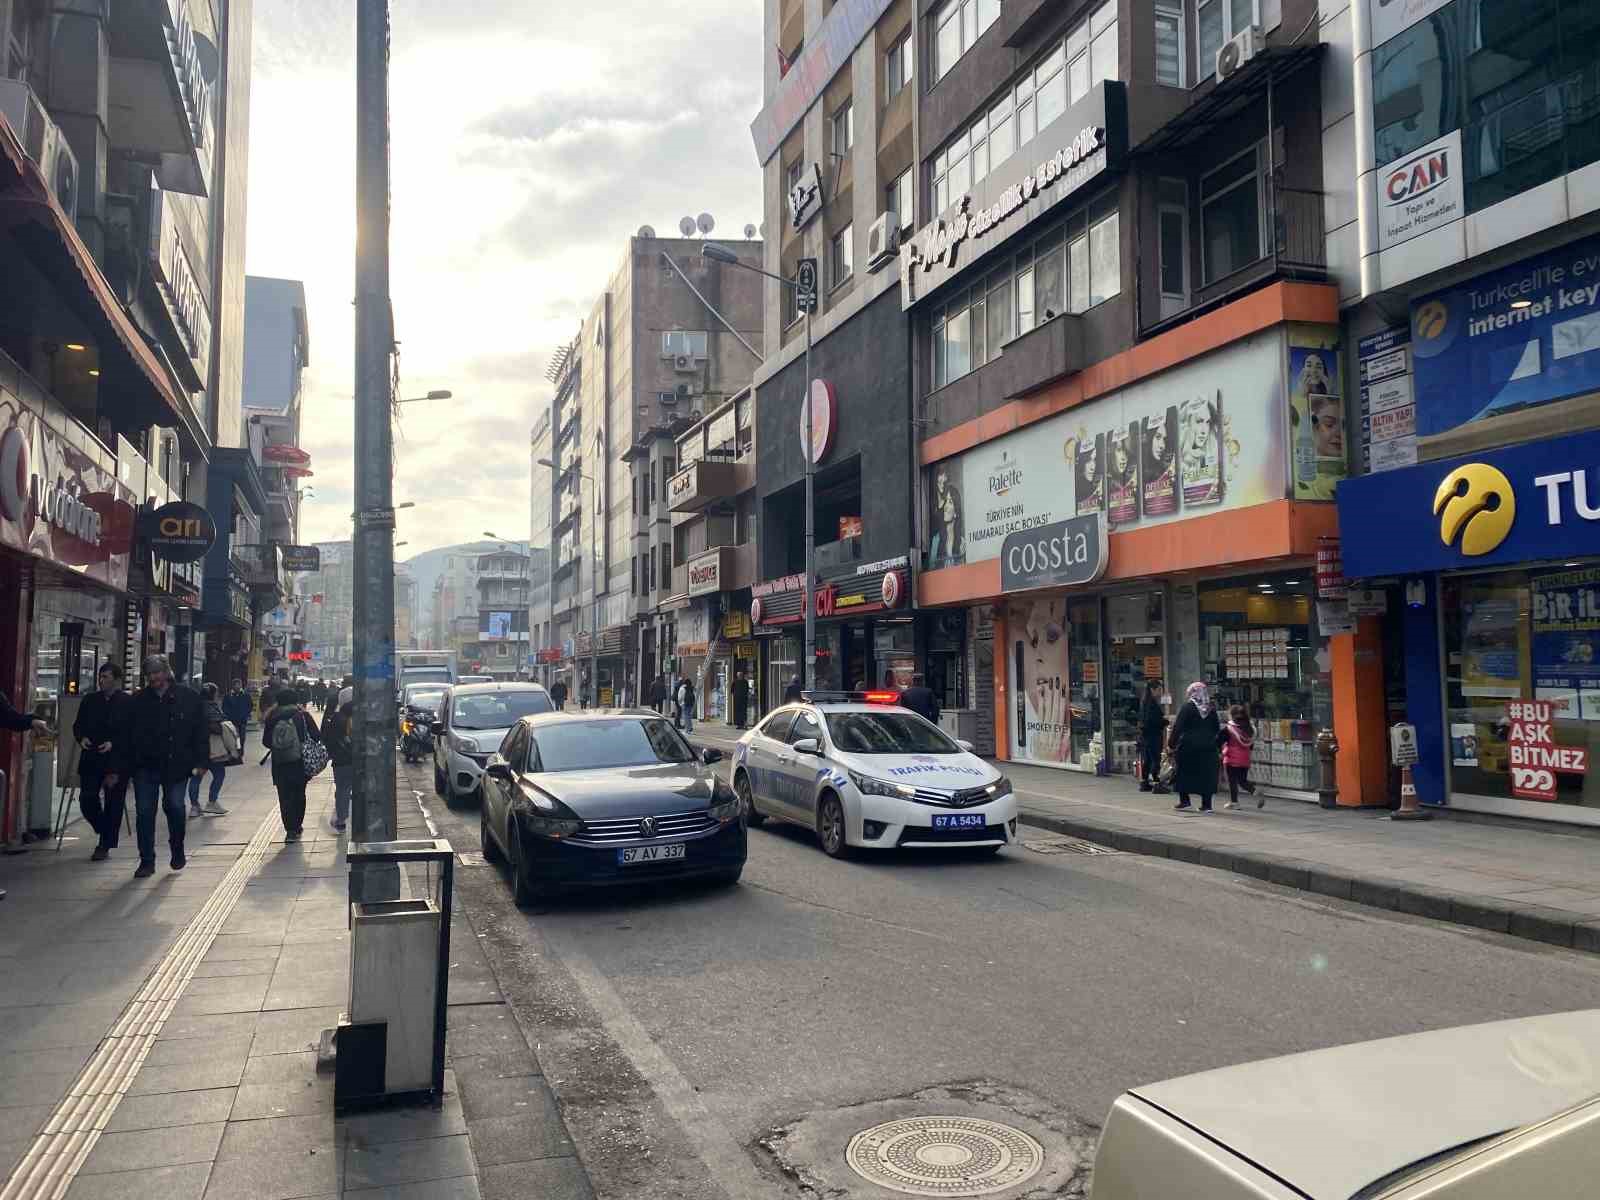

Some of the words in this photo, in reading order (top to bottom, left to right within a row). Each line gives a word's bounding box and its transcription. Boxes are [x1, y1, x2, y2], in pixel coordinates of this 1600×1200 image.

[1386, 152, 1448, 201] CAN
[1468, 295, 1552, 336] internet
[988, 469, 1022, 493] Palette
[1009, 528, 1088, 575] cossta
[1510, 703, 1550, 722] #BU
[1027, 720, 1052, 733] SMOKEY
[1511, 723, 1551, 745] AŞK
[1511, 742, 1585, 770] BİTMEZ
[936, 817, 947, 826] 67
[950, 817, 958, 826] A
[960, 816, 982, 826] 5434
[623, 849, 637, 862] 67
[642, 847, 658, 859] AV
[664, 844, 685, 857] 337
